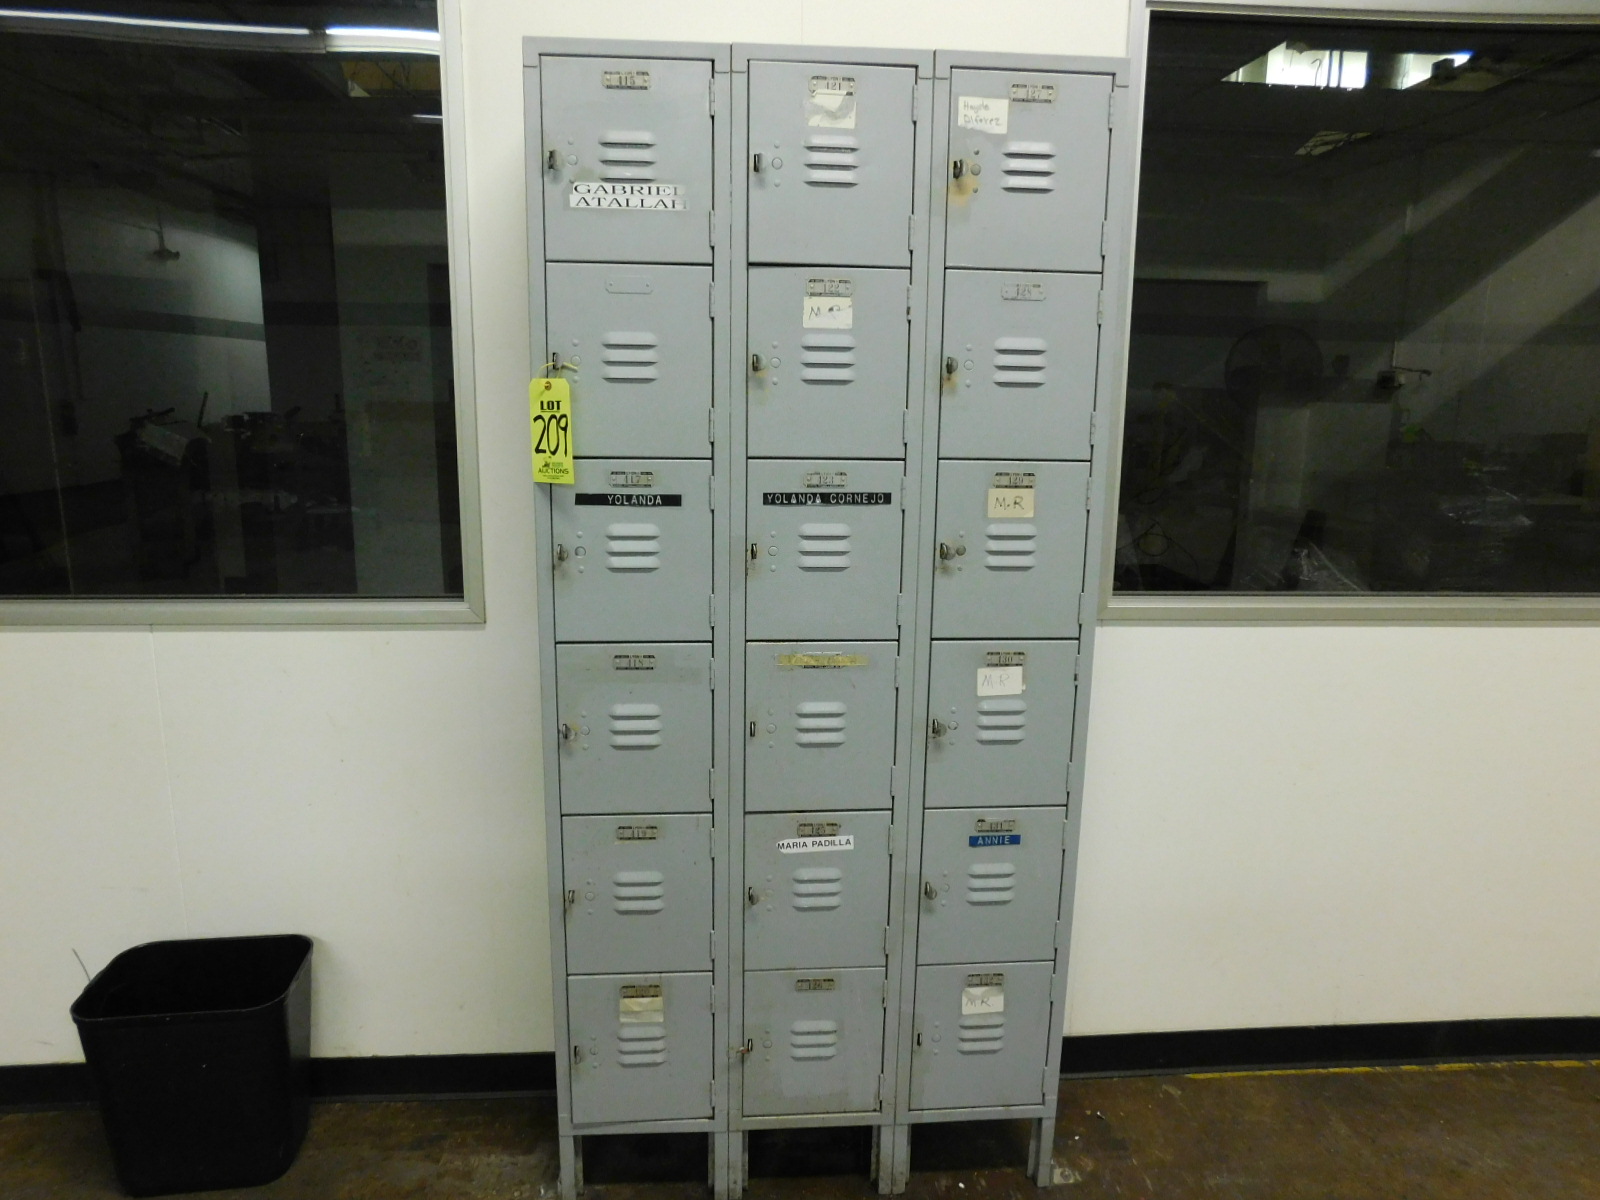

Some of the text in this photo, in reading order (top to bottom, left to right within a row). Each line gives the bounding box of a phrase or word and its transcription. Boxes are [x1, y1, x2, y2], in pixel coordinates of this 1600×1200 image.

[618, 75, 636, 86] 115
[826, 81, 841, 91] 121
[1026, 89, 1042, 99] 127
[573, 183, 685, 196] GABRIEL
[575, 196, 688, 210] ATALLAH
[540, 400, 562, 411] LOT
[532, 413, 569, 458] 209
[537, 467, 570, 475] AUCTIONS
[624, 474, 641, 484] 117
[607, 493, 663, 506] YOLANDA
[767, 493, 885, 505] YOLANDA CORNEJO
[777, 838, 852, 850] MARIA PADILLA
[977, 835, 1011, 845] ANNIE
